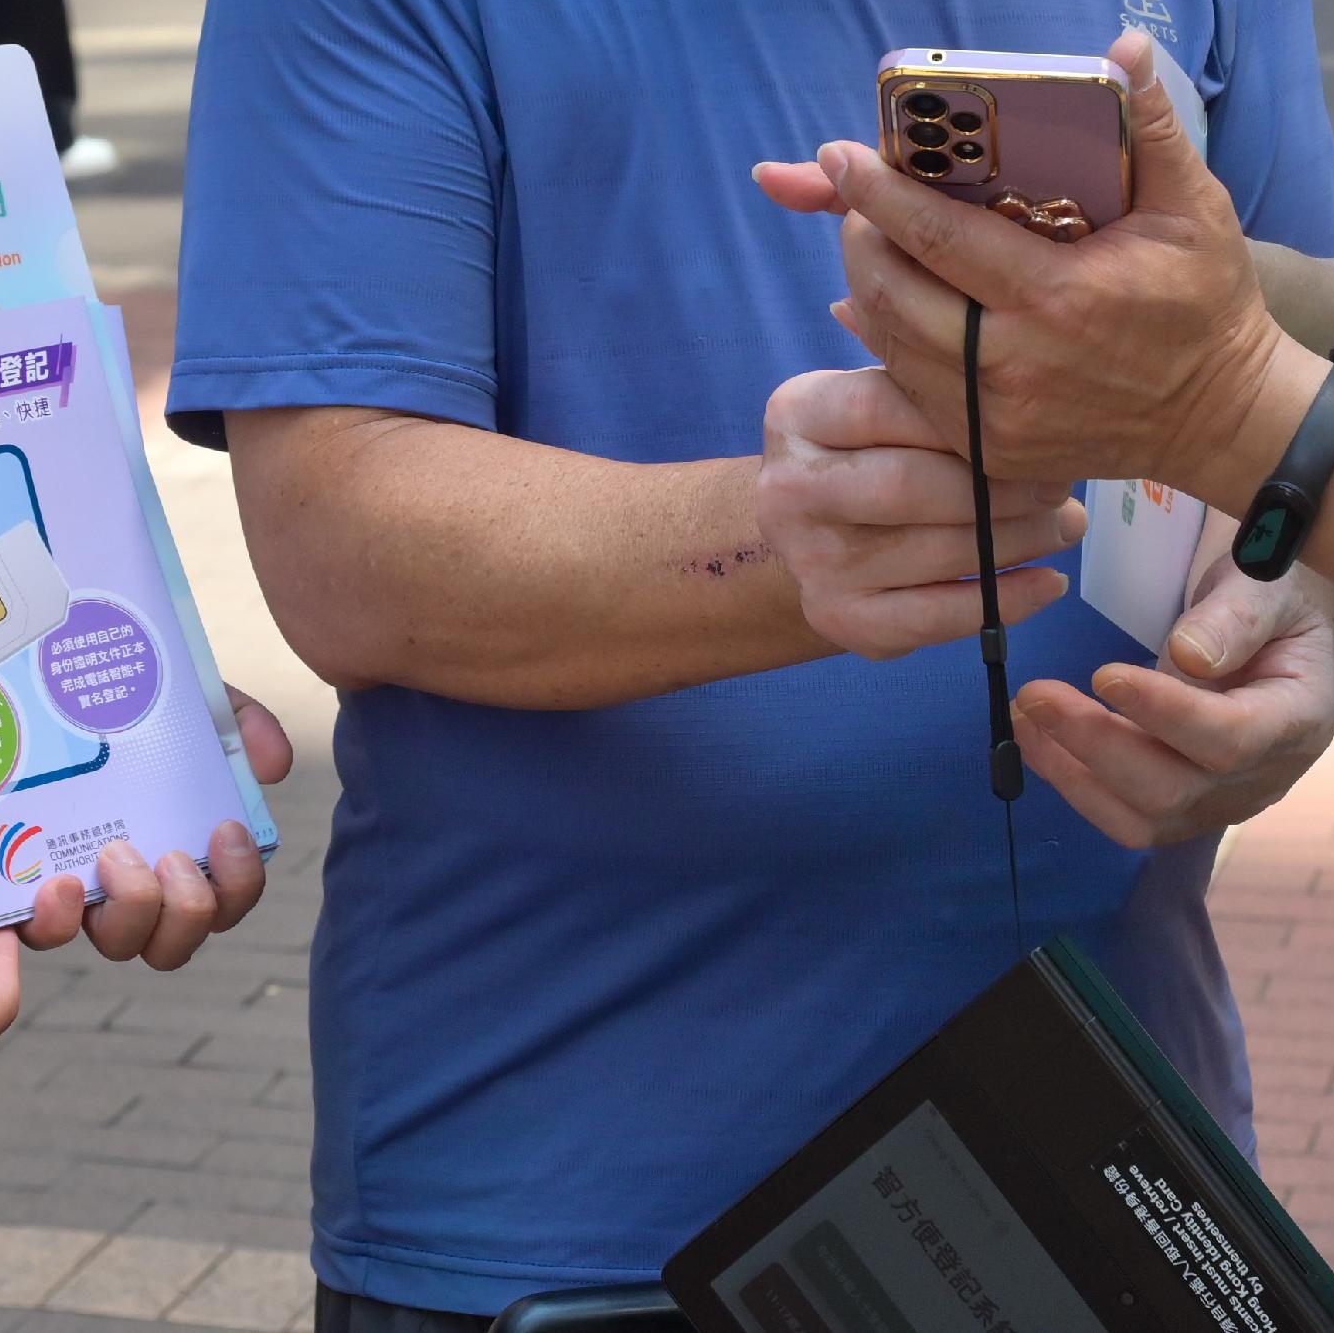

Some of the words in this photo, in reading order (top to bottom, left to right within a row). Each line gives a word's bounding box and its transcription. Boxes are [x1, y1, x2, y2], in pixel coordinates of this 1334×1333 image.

[1128, 1164, 1170, 1215] retrieve
[1153, 1177, 1183, 1212] Card
[1172, 1222, 1205, 1263] insert
[1180, 1211, 1222, 1263] Identity
[1191, 1201, 1249, 1277] themselves
[1201, 1260, 1231, 1296] must
[1219, 1259, 1249, 1298] Kong
[1247, 1275, 1265, 1294] by
[1228, 1295, 1264, 1333] cants
[1247, 1297, 1278, 1333] Hong
